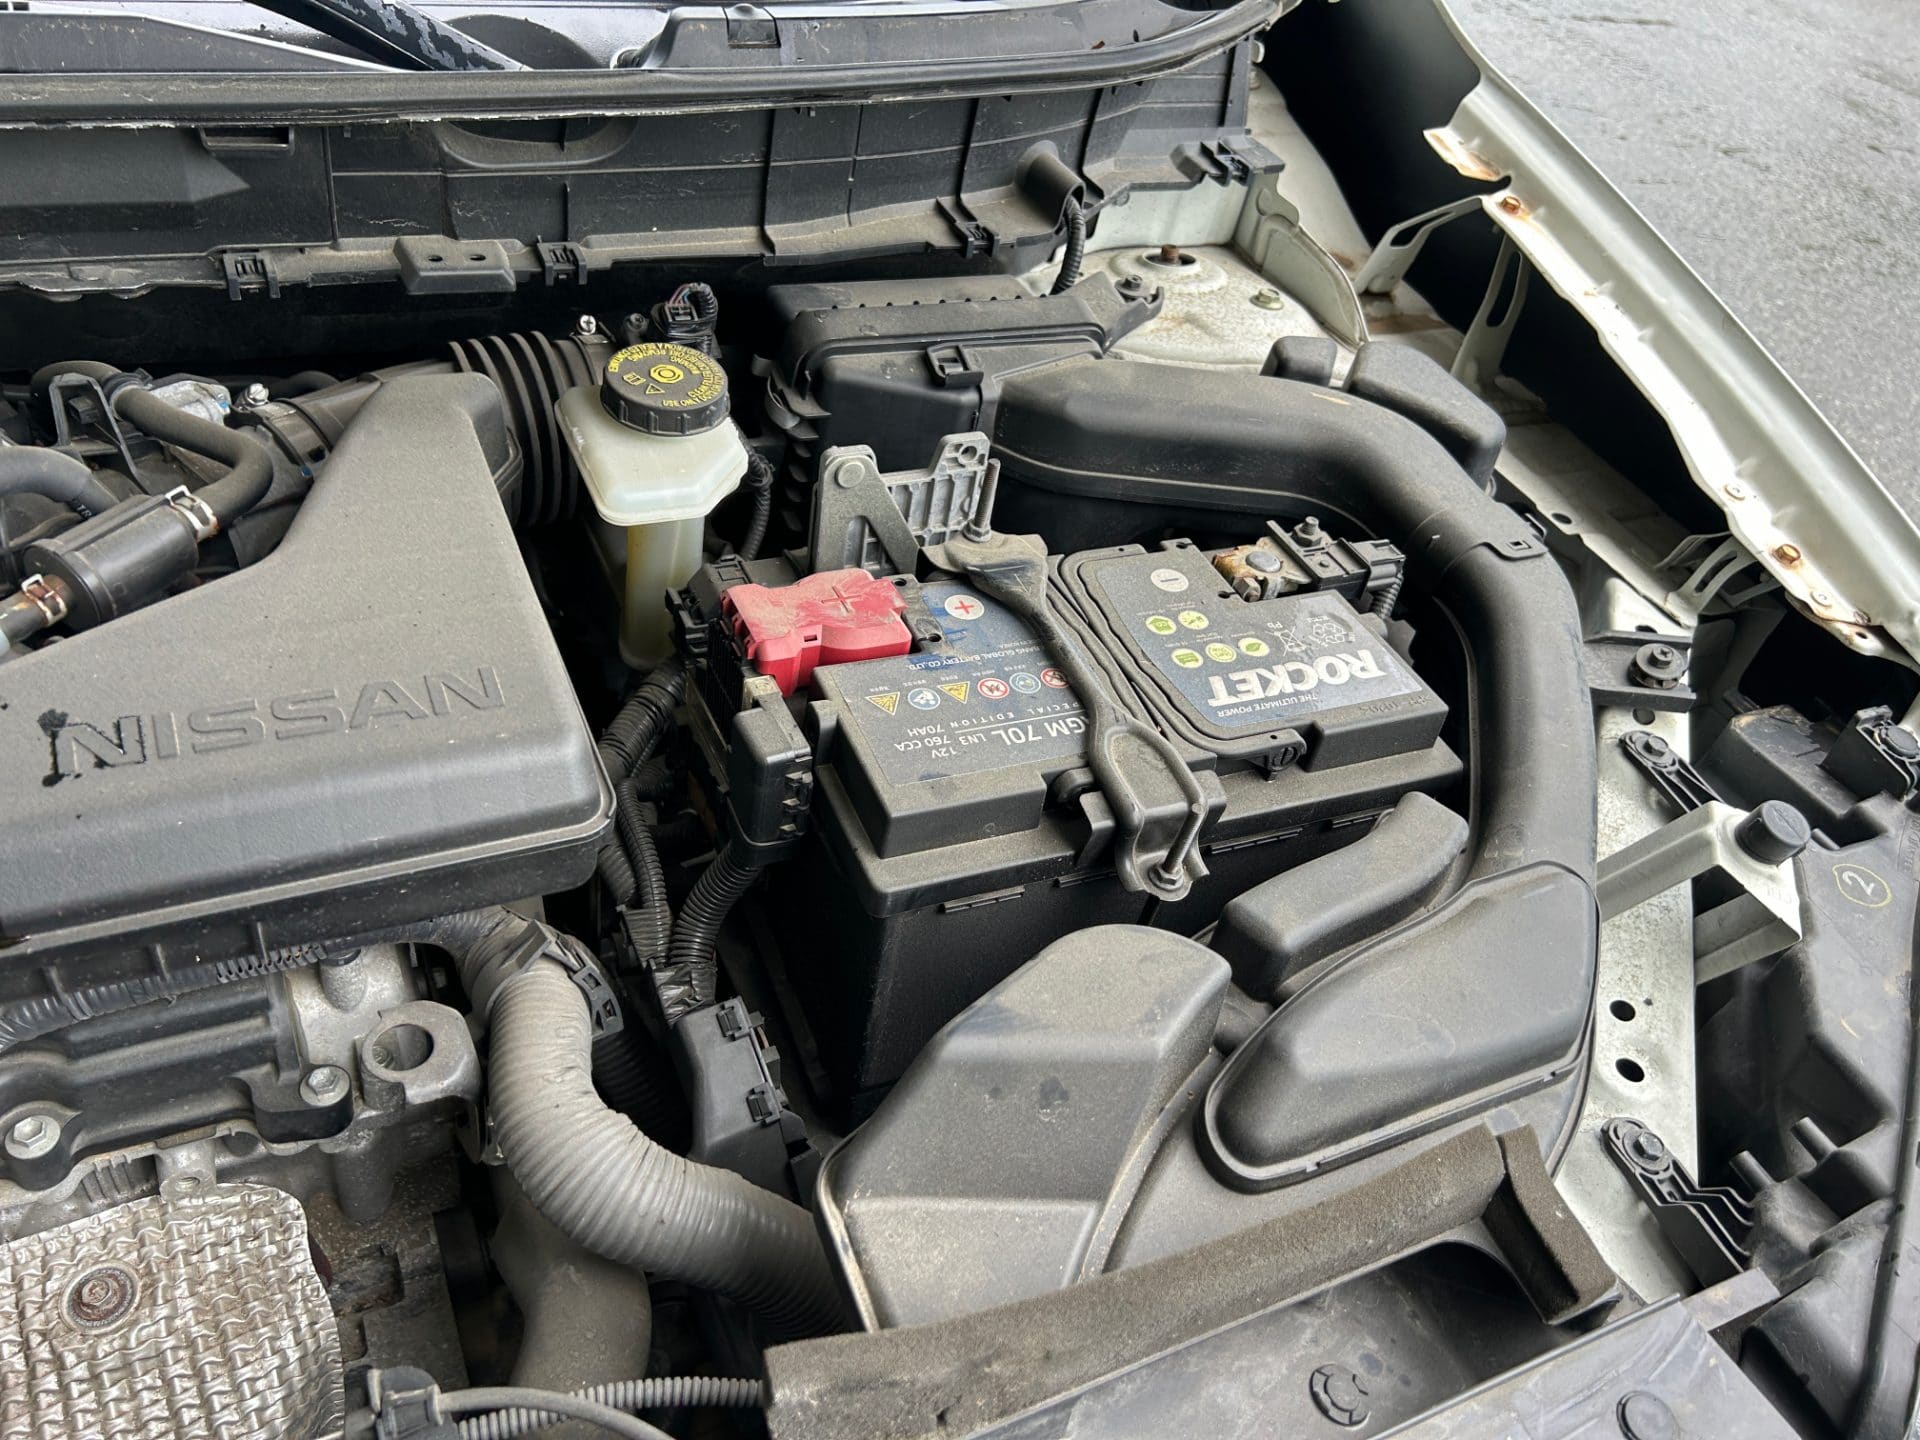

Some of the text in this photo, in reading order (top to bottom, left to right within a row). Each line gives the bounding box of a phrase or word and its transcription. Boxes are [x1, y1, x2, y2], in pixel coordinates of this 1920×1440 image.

[1266, 620, 1284, 629] Pb
[942, 652, 982, 667] BATTERY
[980, 649, 1016, 659] GLOBAL
[1207, 650, 1387, 706] ROCKET
[950, 701, 1080, 728] PECIAL EDITION
[1216, 693, 1319, 718] THE ULTIMATE POWER
[51, 666, 506, 775] NISSAN
[906, 723, 946, 738] 70AH
[958, 732, 987, 746] LN3
[990, 723, 1042, 746] 70L
[894, 734, 952, 752] 760 CCA
[930, 746, 958, 760] 12V
[1842, 870, 1876, 896] 2
